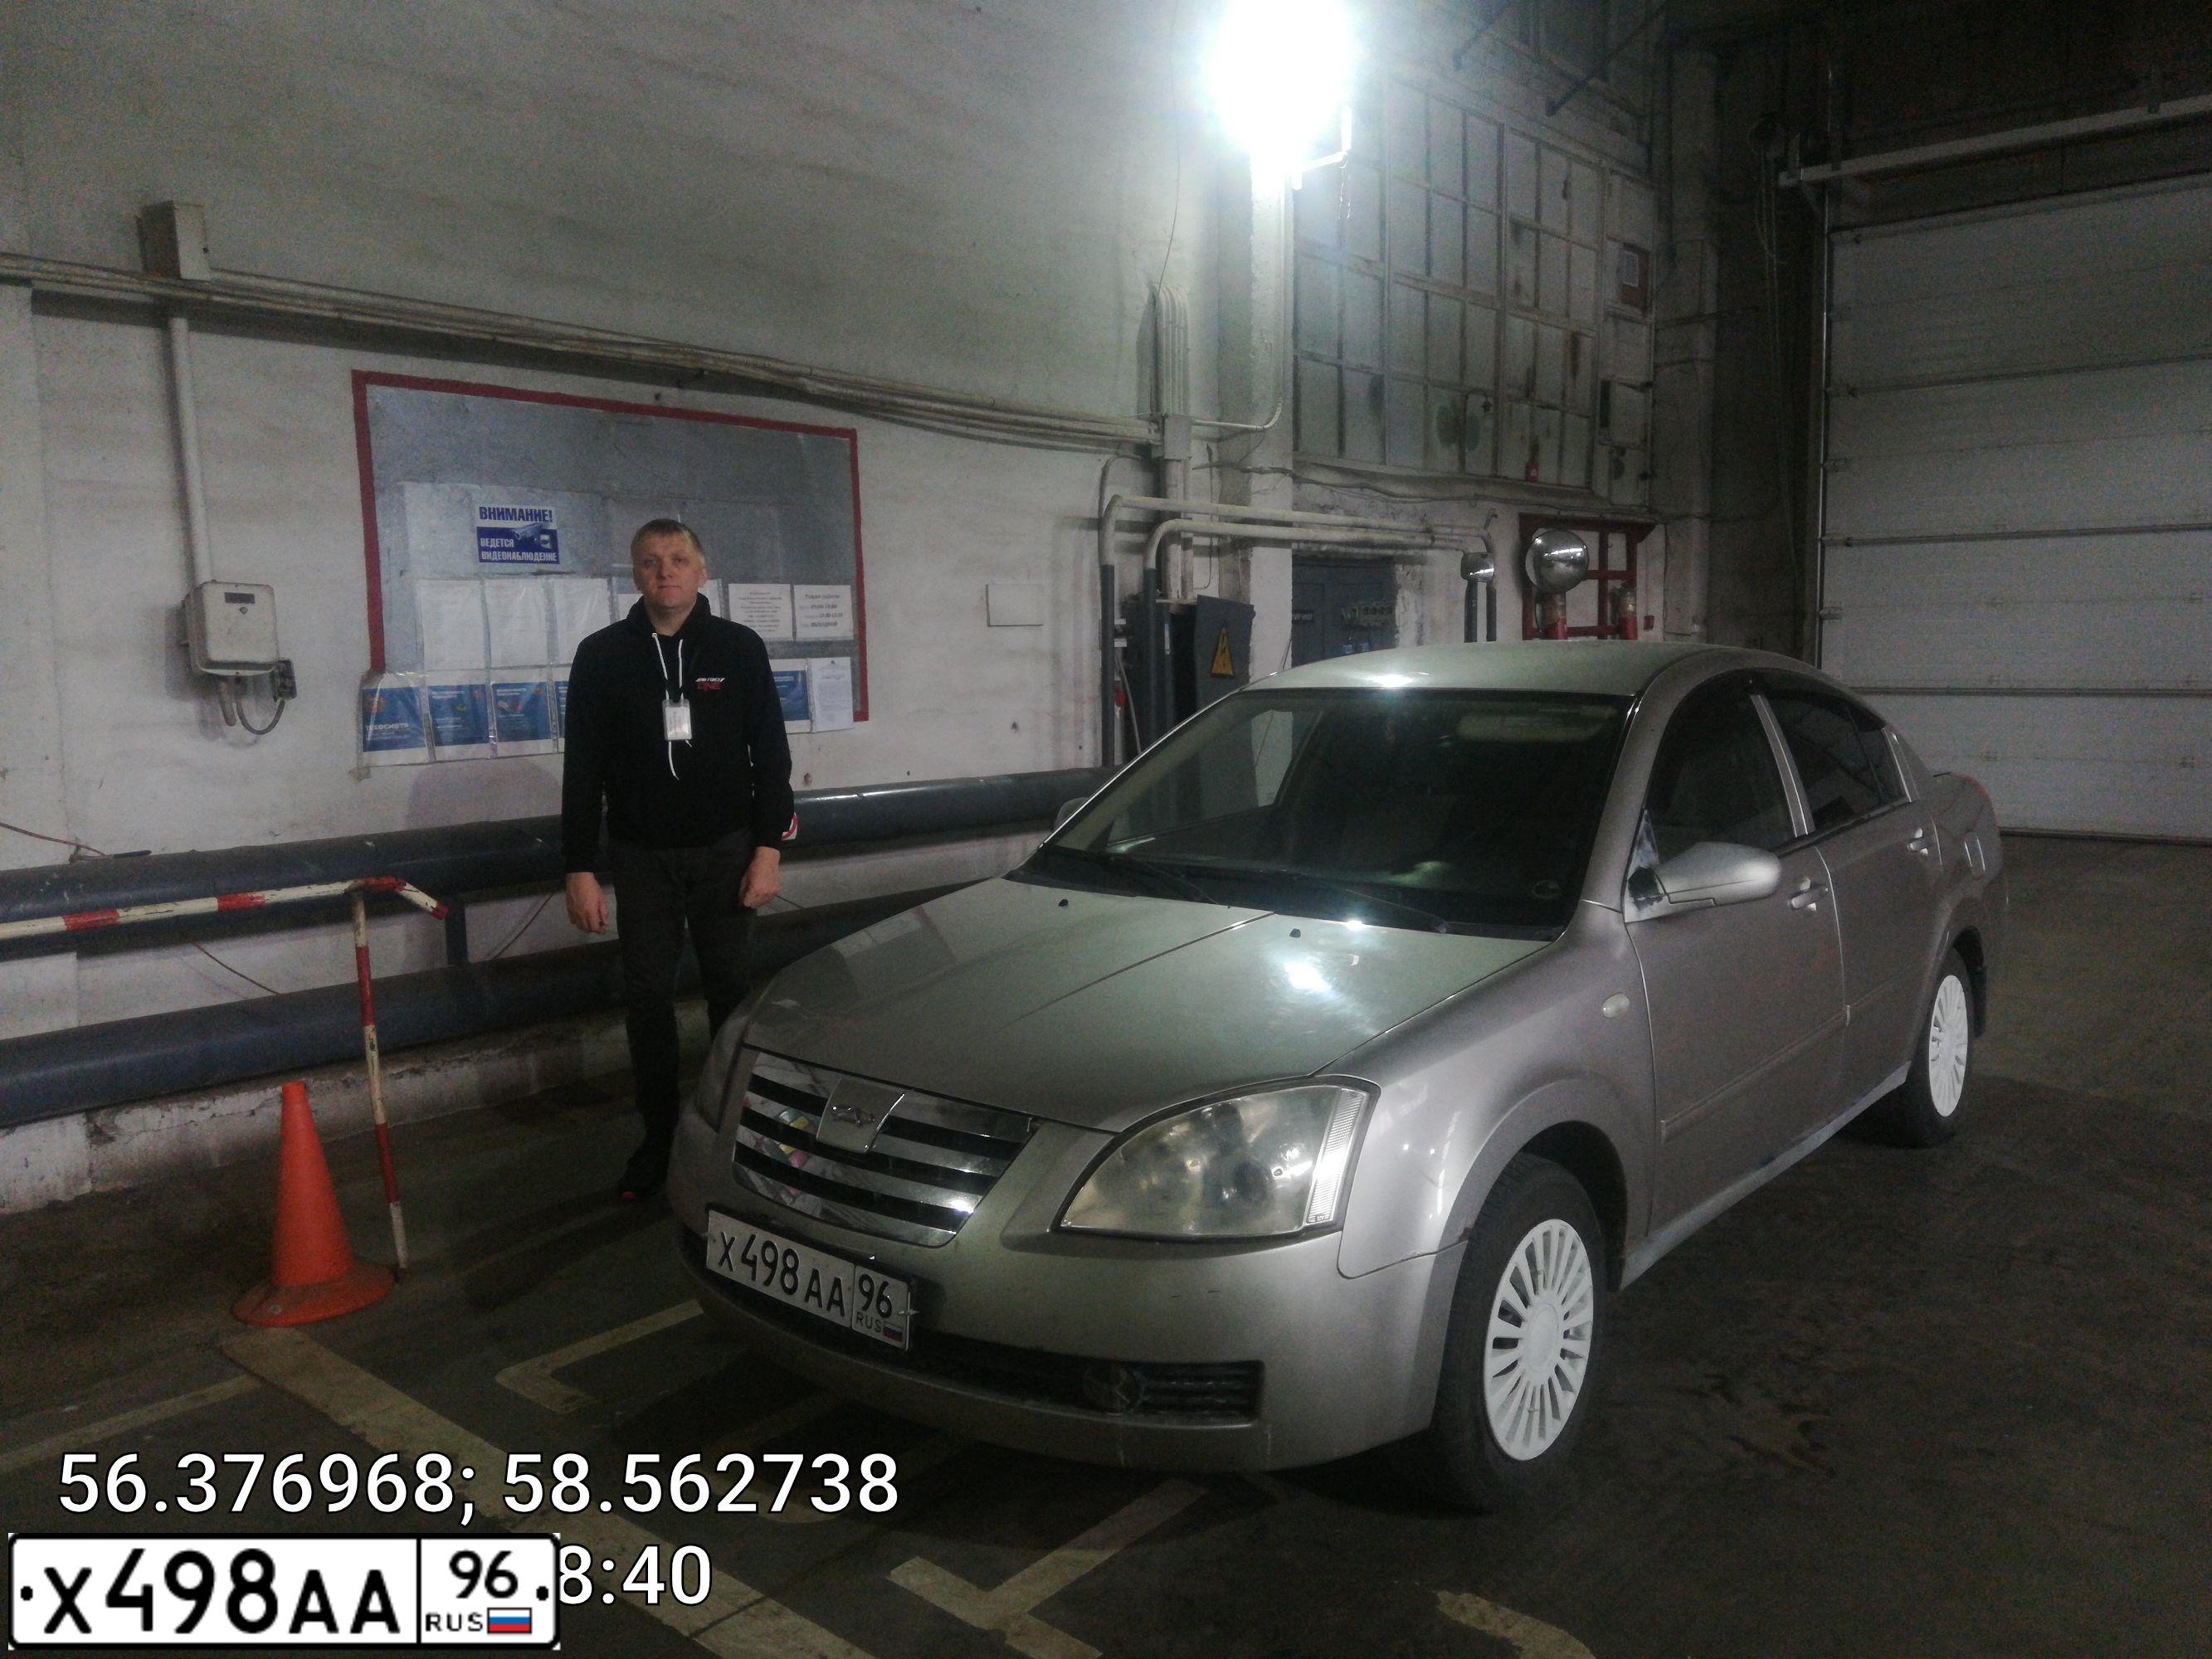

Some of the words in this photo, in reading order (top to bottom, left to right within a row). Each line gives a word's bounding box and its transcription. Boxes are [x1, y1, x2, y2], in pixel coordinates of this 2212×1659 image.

[479, 507, 553, 523] ВНИМАНИЕ!
[480, 538, 514, 548] ВЕДЕТСЯ
[481, 551, 558, 562] ВИДЕОНАБЛЮДЕНИЕ
[858, 1273, 893, 1319] 96
[855, 1311, 882, 1334] RUS
